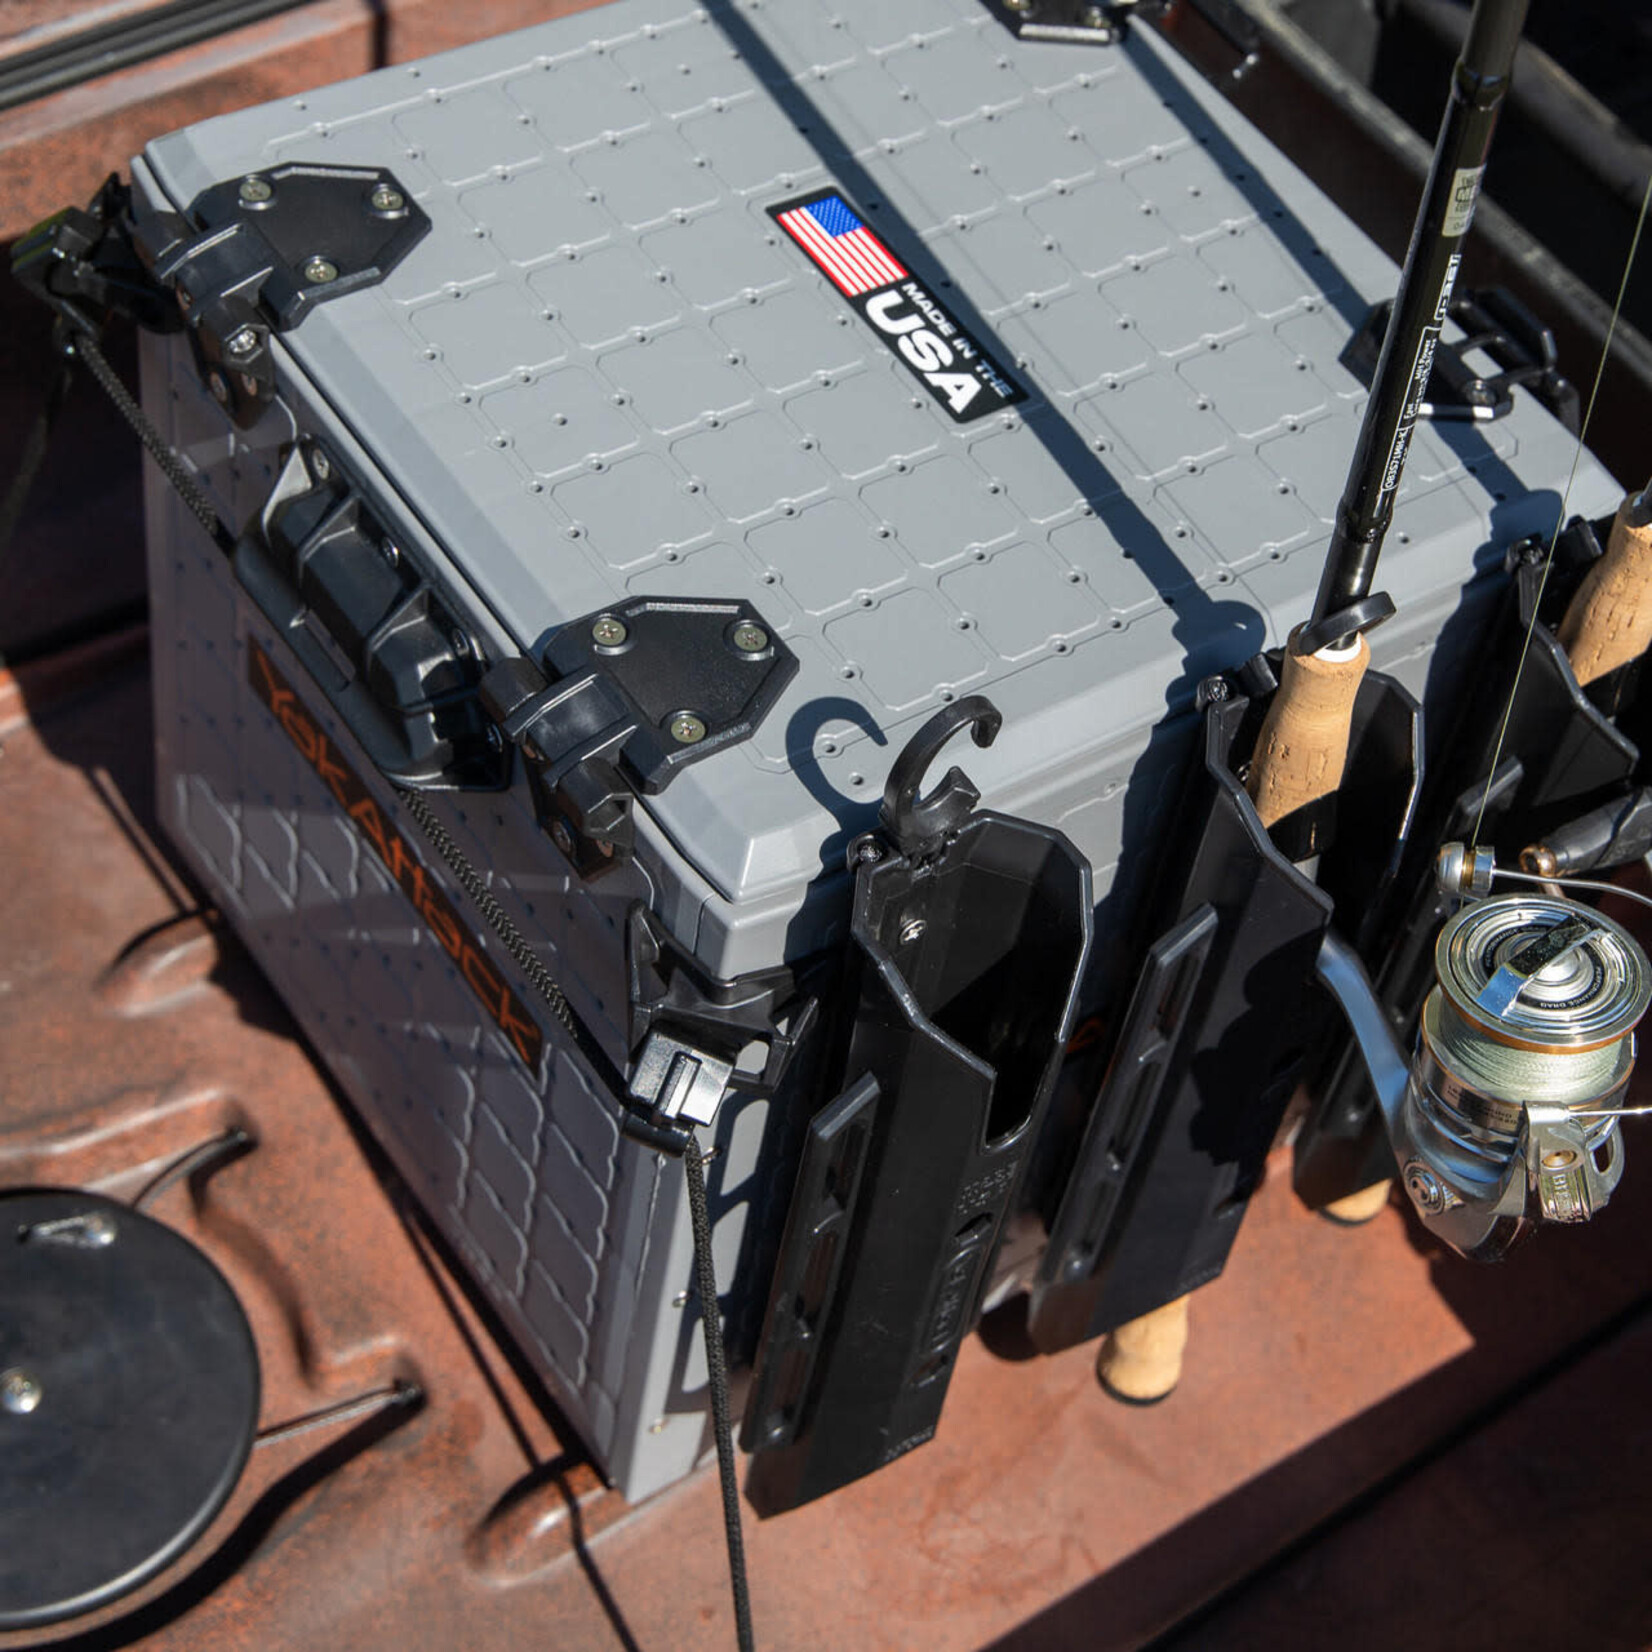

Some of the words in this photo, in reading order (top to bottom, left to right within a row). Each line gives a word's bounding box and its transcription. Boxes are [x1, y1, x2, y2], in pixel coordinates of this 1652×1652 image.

[865, 290, 982, 414] USA
[902, 282, 956, 336] MADE
[953, 338, 977, 359] IN
[976, 360, 1014, 398] THE
